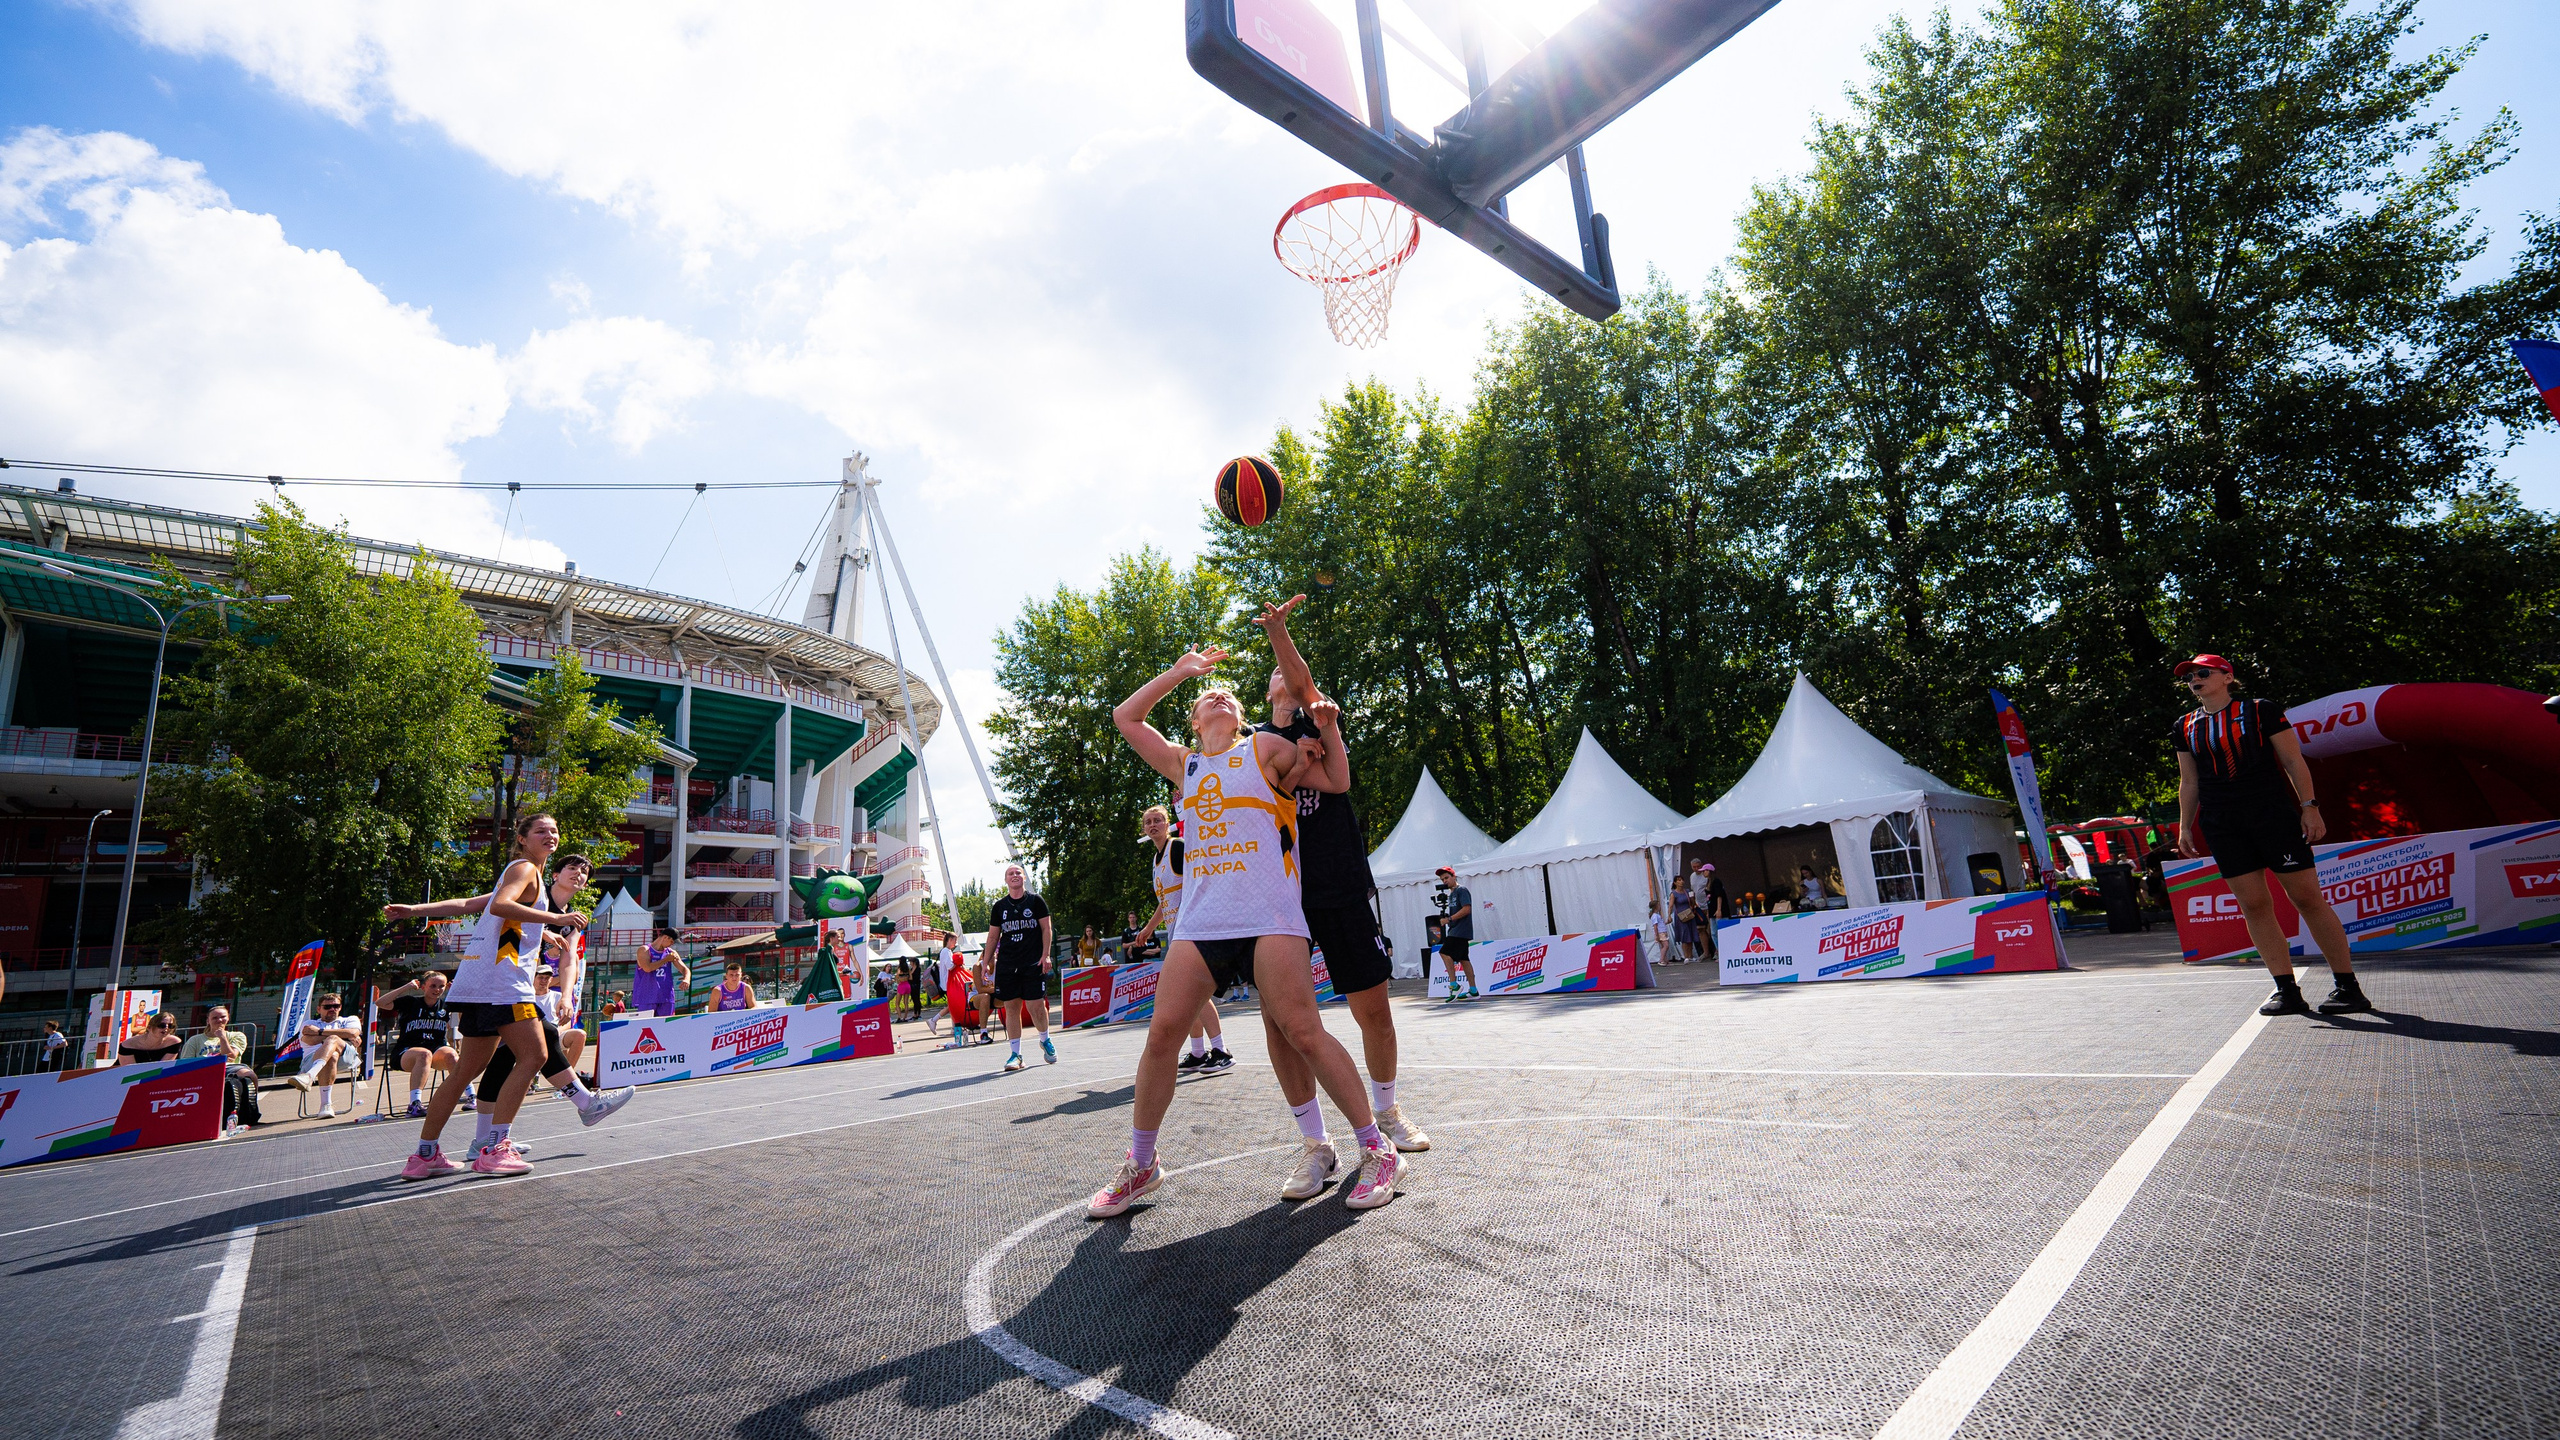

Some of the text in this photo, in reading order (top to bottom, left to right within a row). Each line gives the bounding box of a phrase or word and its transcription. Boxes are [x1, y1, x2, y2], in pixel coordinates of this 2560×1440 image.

[2292, 702, 2367, 744] РЖД
[1229, 757, 1243, 768] 8
[1185, 841, 1259, 863] КРАСНАЯ
[2348, 861, 2361, 869] ПО
[2364, 843, 2426, 865] БАСКЕТБОЛУ
[2501, 854, 2550, 863] ГЕНЕРАЛЬНЫЙ
[1193, 860, 1247, 878] ПАХРА
[2329, 875, 2341, 883] НА
[2344, 865, 2375, 879] КУБОК
[2378, 860, 2397, 870] ОАО
[2400, 850, 2433, 863] «РЖД»
[2322, 858, 2444, 905] ДОСТИГАЯ
[2520, 869, 2560, 889] РЖ
[2188, 893, 2238, 916] АС
[2362, 878, 2445, 913] ЦЕЛИ!
[1002, 910, 1008, 919] 6
[1821, 921, 1842, 932] ТУРНИР
[1853, 908, 1889, 922] БАСКЕТБОЛУ
[2349, 901, 2449, 932] ДНЯ ЖЕЛЕЗНОДОРОЖНИКА
[2405, 918, 2441, 931] АВГУСТА
[2443, 912, 2463, 922] 2025
[1823, 919, 1897, 952] ДОСТИГАЯ
[1841, 923, 1860, 931] КУБОК
[1995, 925, 2033, 941] РЖД
[1374, 935, 1387, 956] 4
[1848, 932, 1896, 957] ЦЕЛИ!
[1495, 948, 1544, 972] ДОСТИГАЯ
[1510, 958, 1541, 976] ЦЕЛИ!
[1601, 954, 1624, 967] РЖД
[1727, 956, 1792, 969] ЛОКОМОТИВ
[656, 968, 665, 977] 22
[1070, 987, 1101, 1003] АСБ
[1116, 974, 1157, 997] ДОСТИГАЯ
[1130, 984, 1156, 1001] ЦЕЛИ!
[715, 1021, 735, 1031] ТУРНИР
[745, 1009, 776, 1022] БАСКЕТБОЛУ
[733, 1022, 750, 1030] КУБОК
[855, 1021, 880, 1034] РЖД
[716, 1018, 783, 1049] ДОСТИГАЯ
[739, 1029, 781, 1052] ЦЕЛИ!
[611, 1054, 685, 1072] ЛОКОМОТИВ
[631, 1067, 666, 1075] КУБАНЬ
[150, 1092, 200, 1113] РЖД
